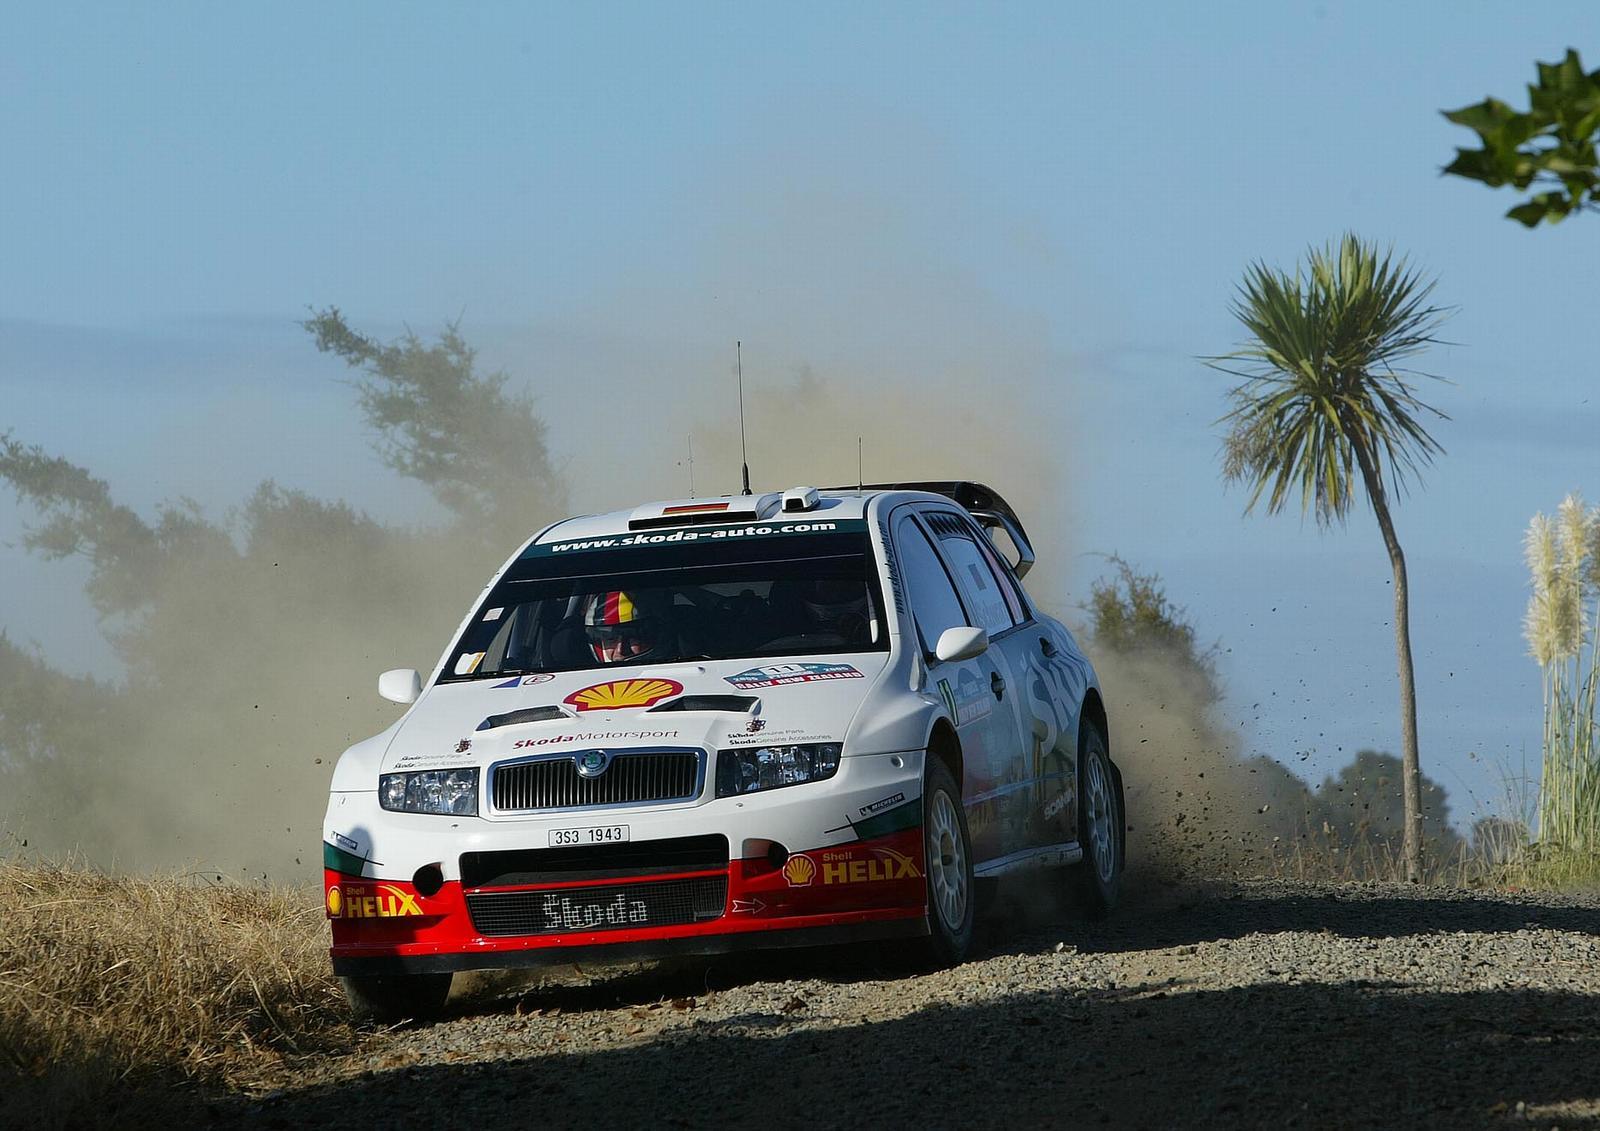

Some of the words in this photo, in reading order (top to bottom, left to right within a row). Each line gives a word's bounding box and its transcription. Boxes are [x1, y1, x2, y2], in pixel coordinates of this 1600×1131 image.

[551, 521, 837, 553] www.skoda-auto.com
[768, 664, 795, 674] 11
[735, 680, 773, 690] RALLY
[775, 676, 805, 685] NEW
[806, 671, 862, 682] ZEALAND
[555, 829, 579, 844] 3S3
[588, 826, 622, 842] 1943
[823, 851, 852, 861] Shell
[822, 854, 919, 884] HELIX
[346, 887, 365, 896] Shell
[346, 893, 423, 918] HELIX
